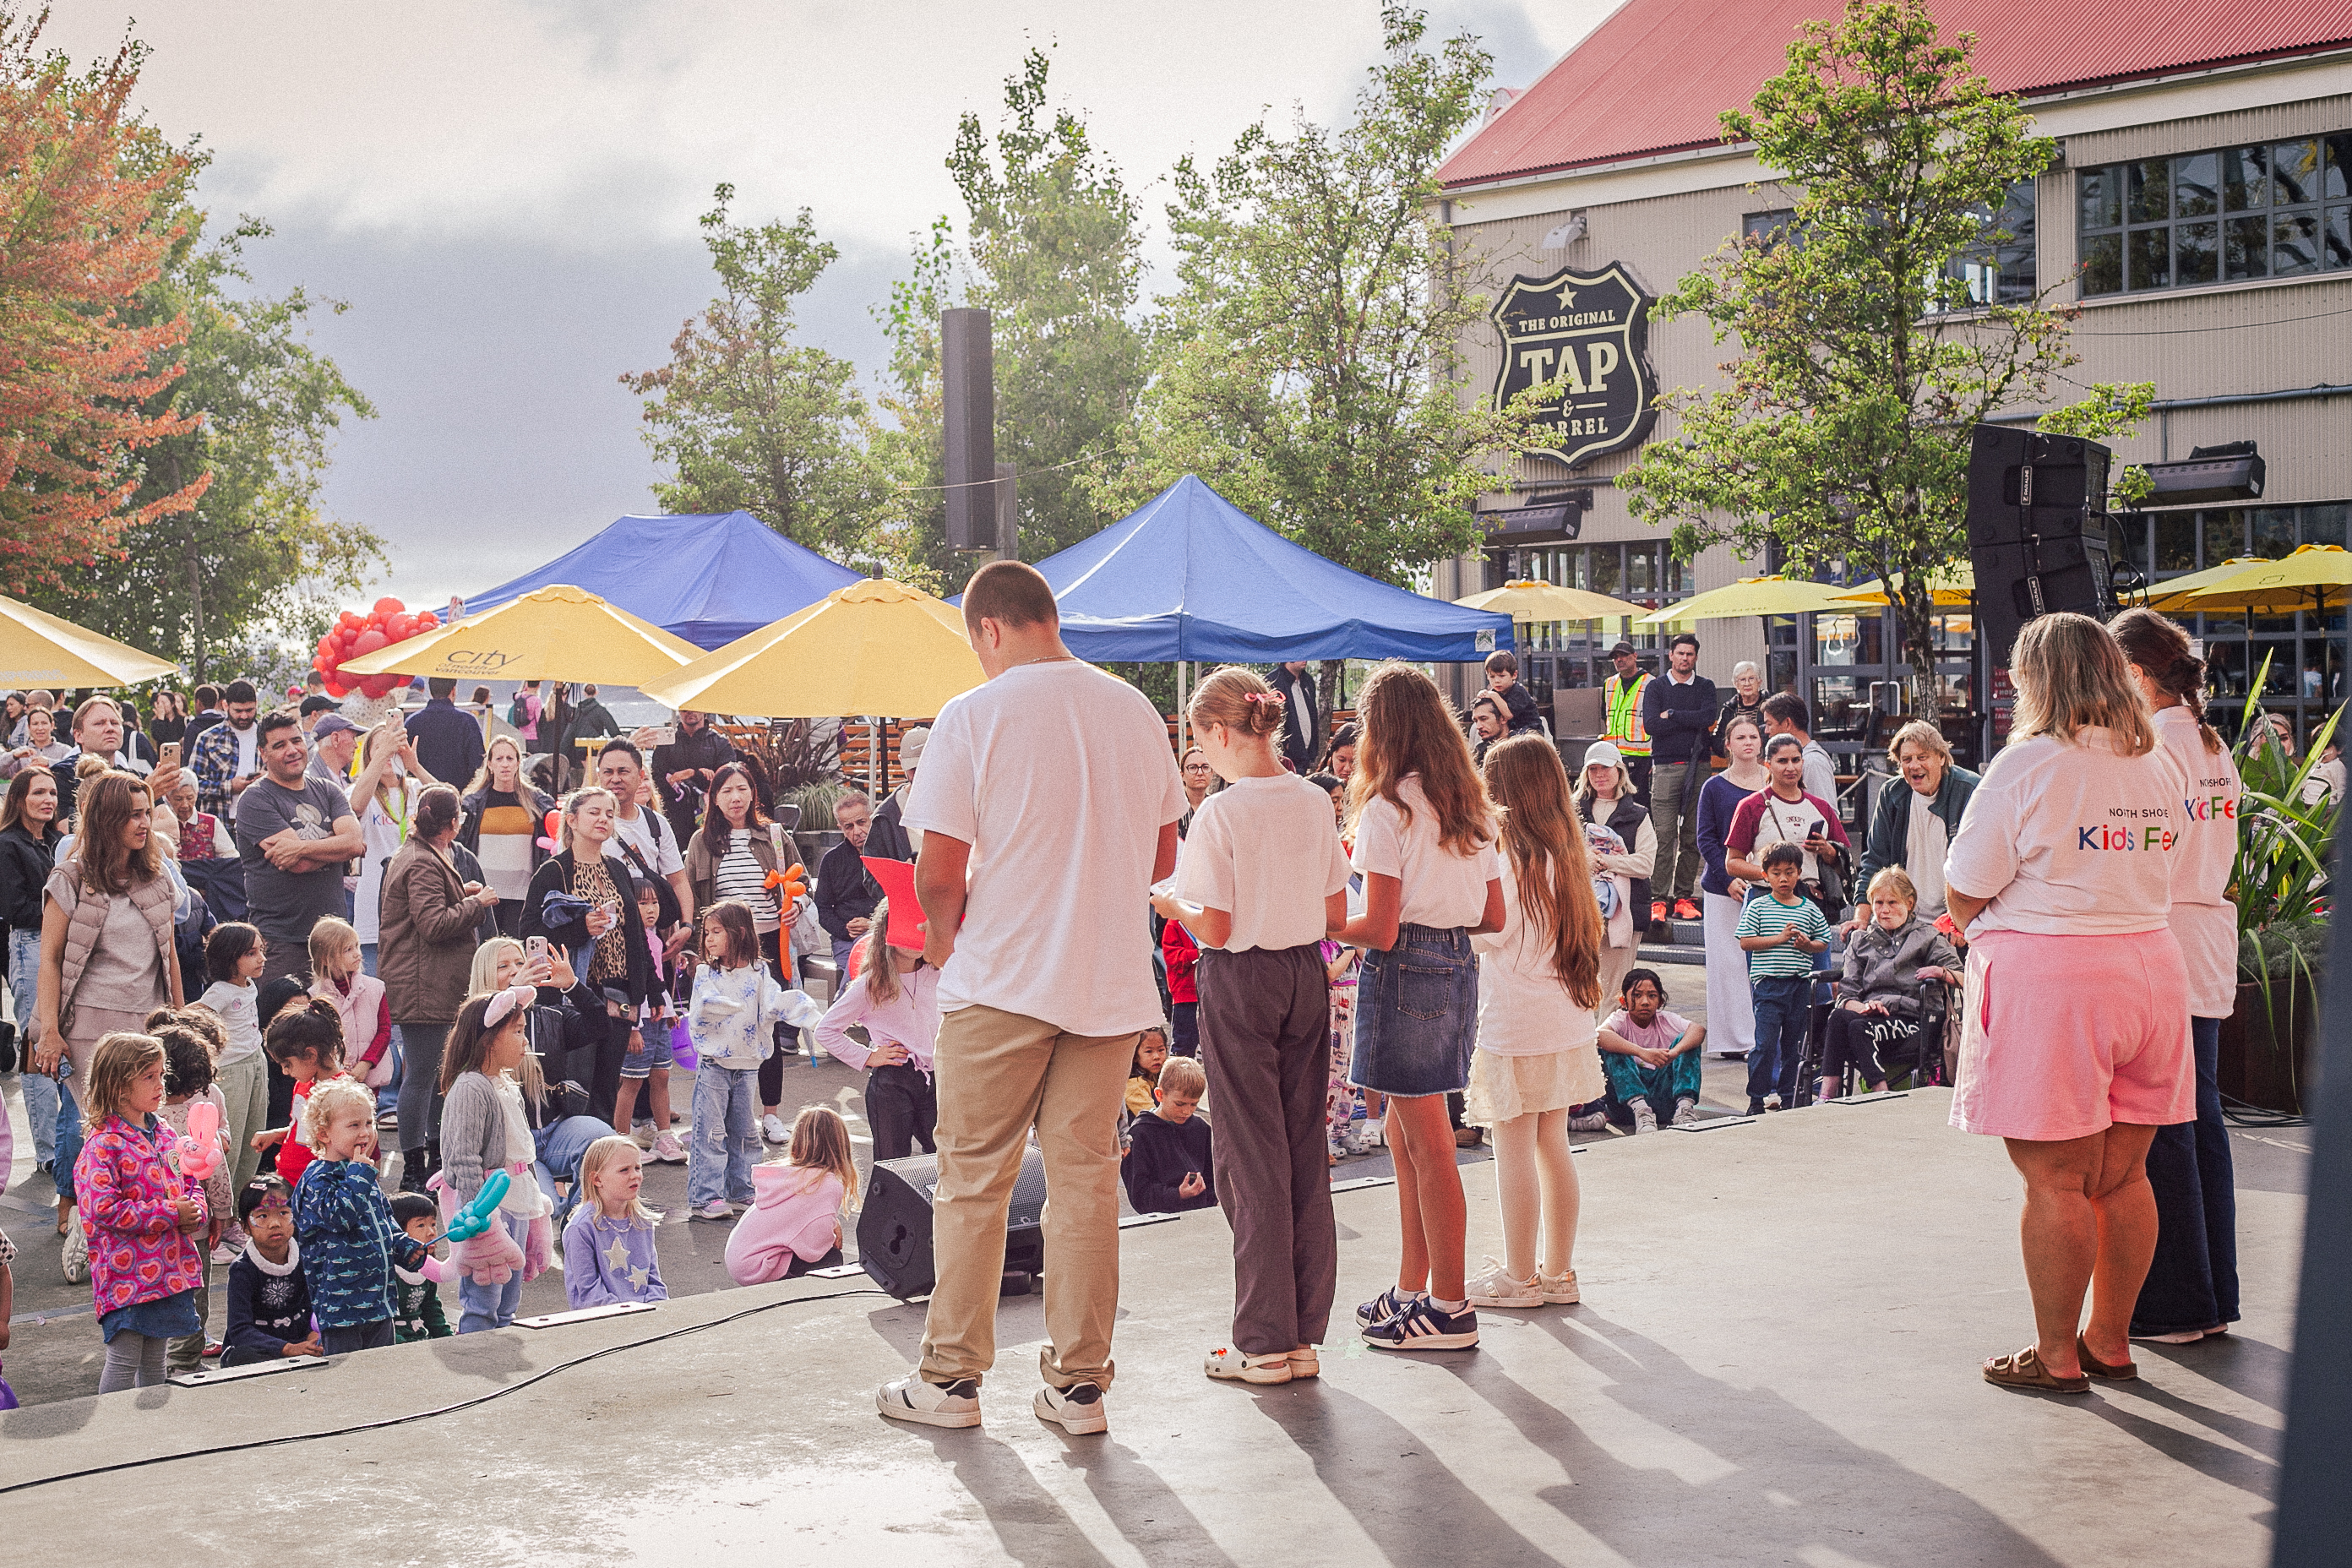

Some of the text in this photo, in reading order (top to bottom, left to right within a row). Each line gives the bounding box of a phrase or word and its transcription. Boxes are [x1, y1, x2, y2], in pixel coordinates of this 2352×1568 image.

[1518, 309, 1616, 333] THE ORIGINAL
[1520, 341, 1619, 395] TAP
[1562, 399, 1574, 418] &
[435, 667, 500, 675] vancouver
[2142, 808, 2169, 819] SHOE
[2078, 824, 2135, 852] Kids
